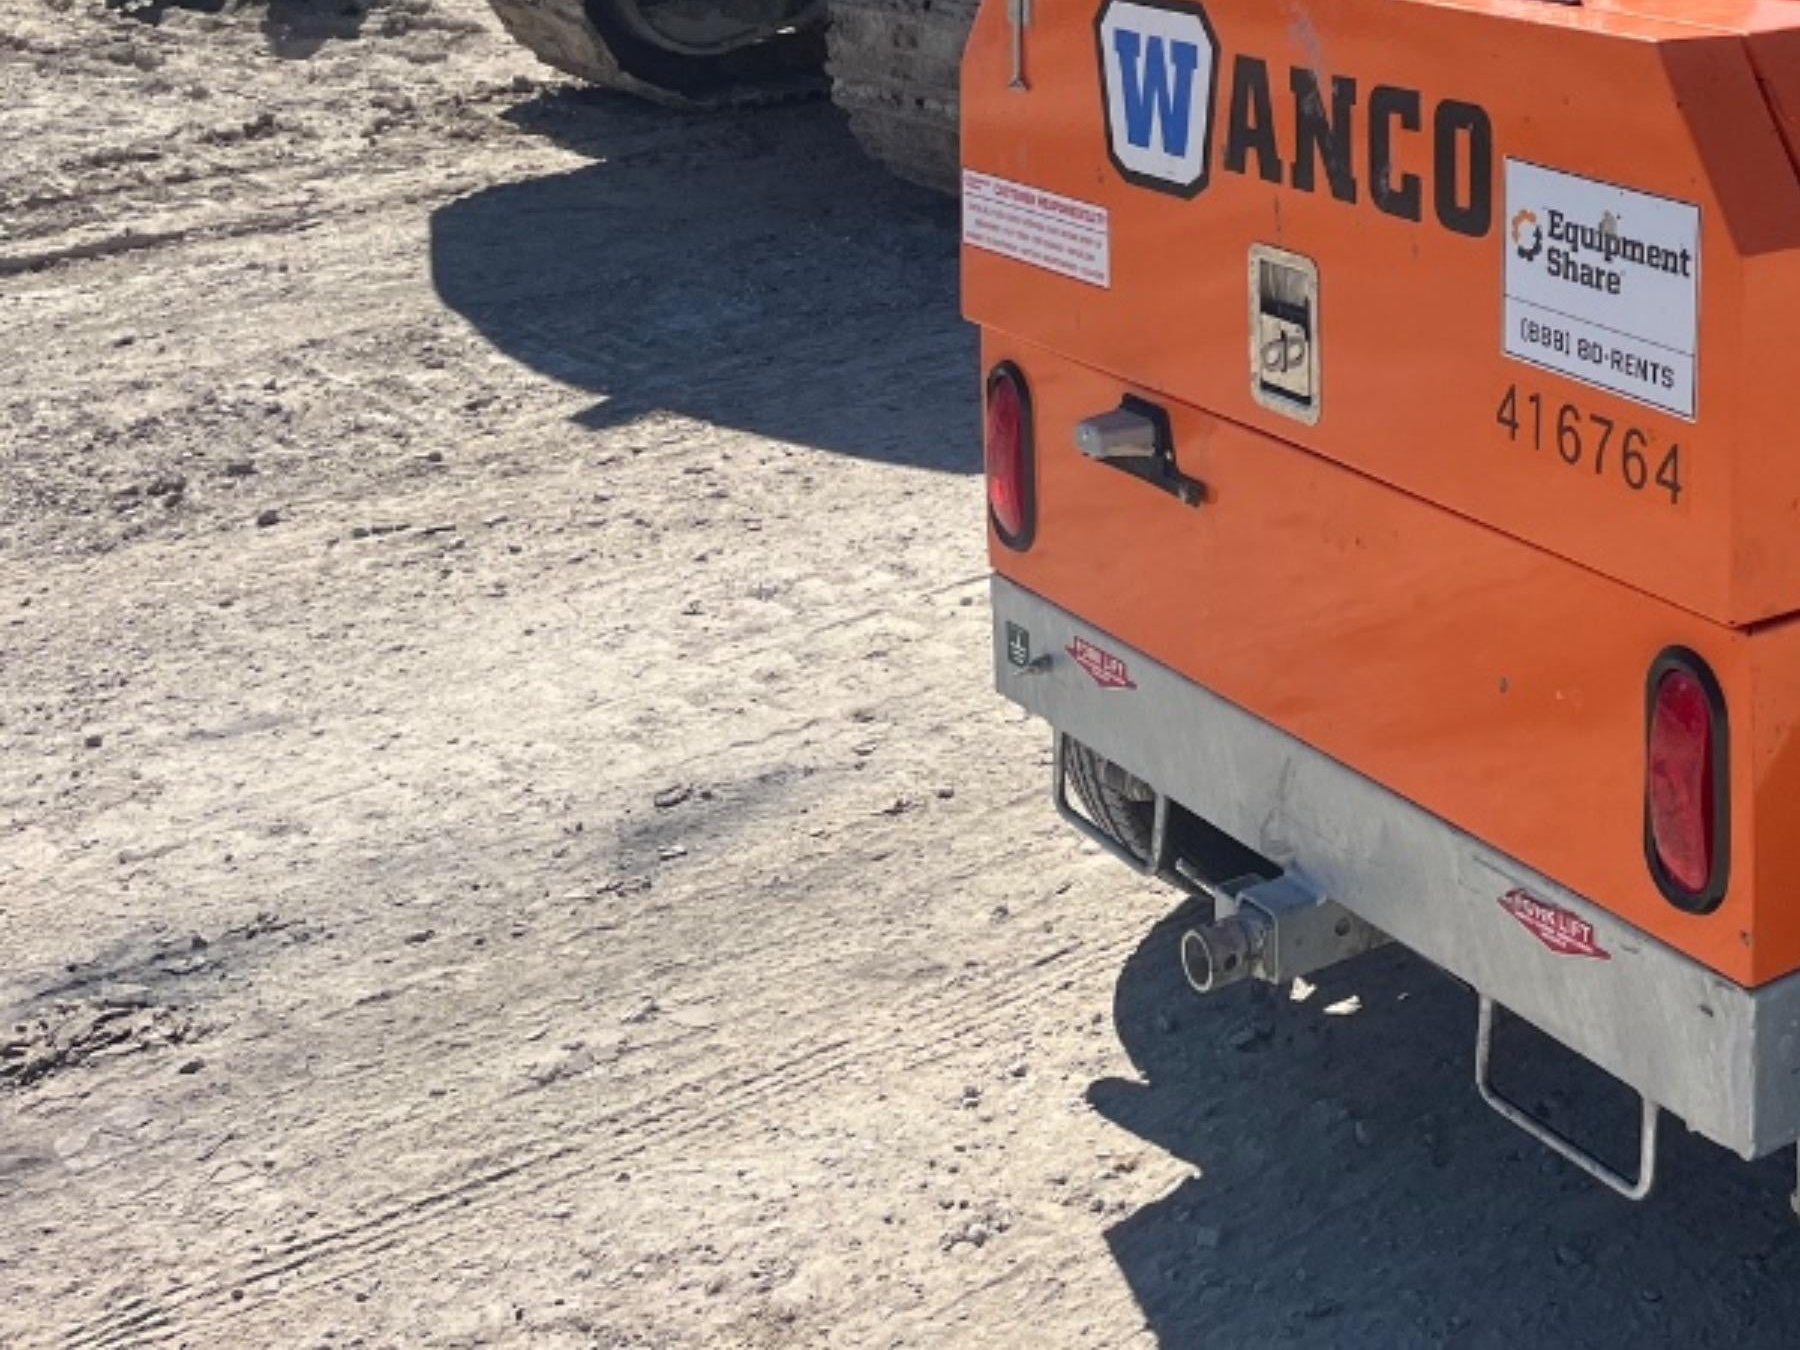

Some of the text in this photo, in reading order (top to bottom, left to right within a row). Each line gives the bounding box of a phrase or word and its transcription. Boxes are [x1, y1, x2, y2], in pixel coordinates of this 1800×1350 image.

[1110, 26, 1492, 238] WANCO
[1546, 209, 1691, 279] Equipment
[1546, 247, 1622, 295] Share
[1519, 316, 1675, 390] (888) 80-RENTS
[1496, 383, 1683, 505] 416764
